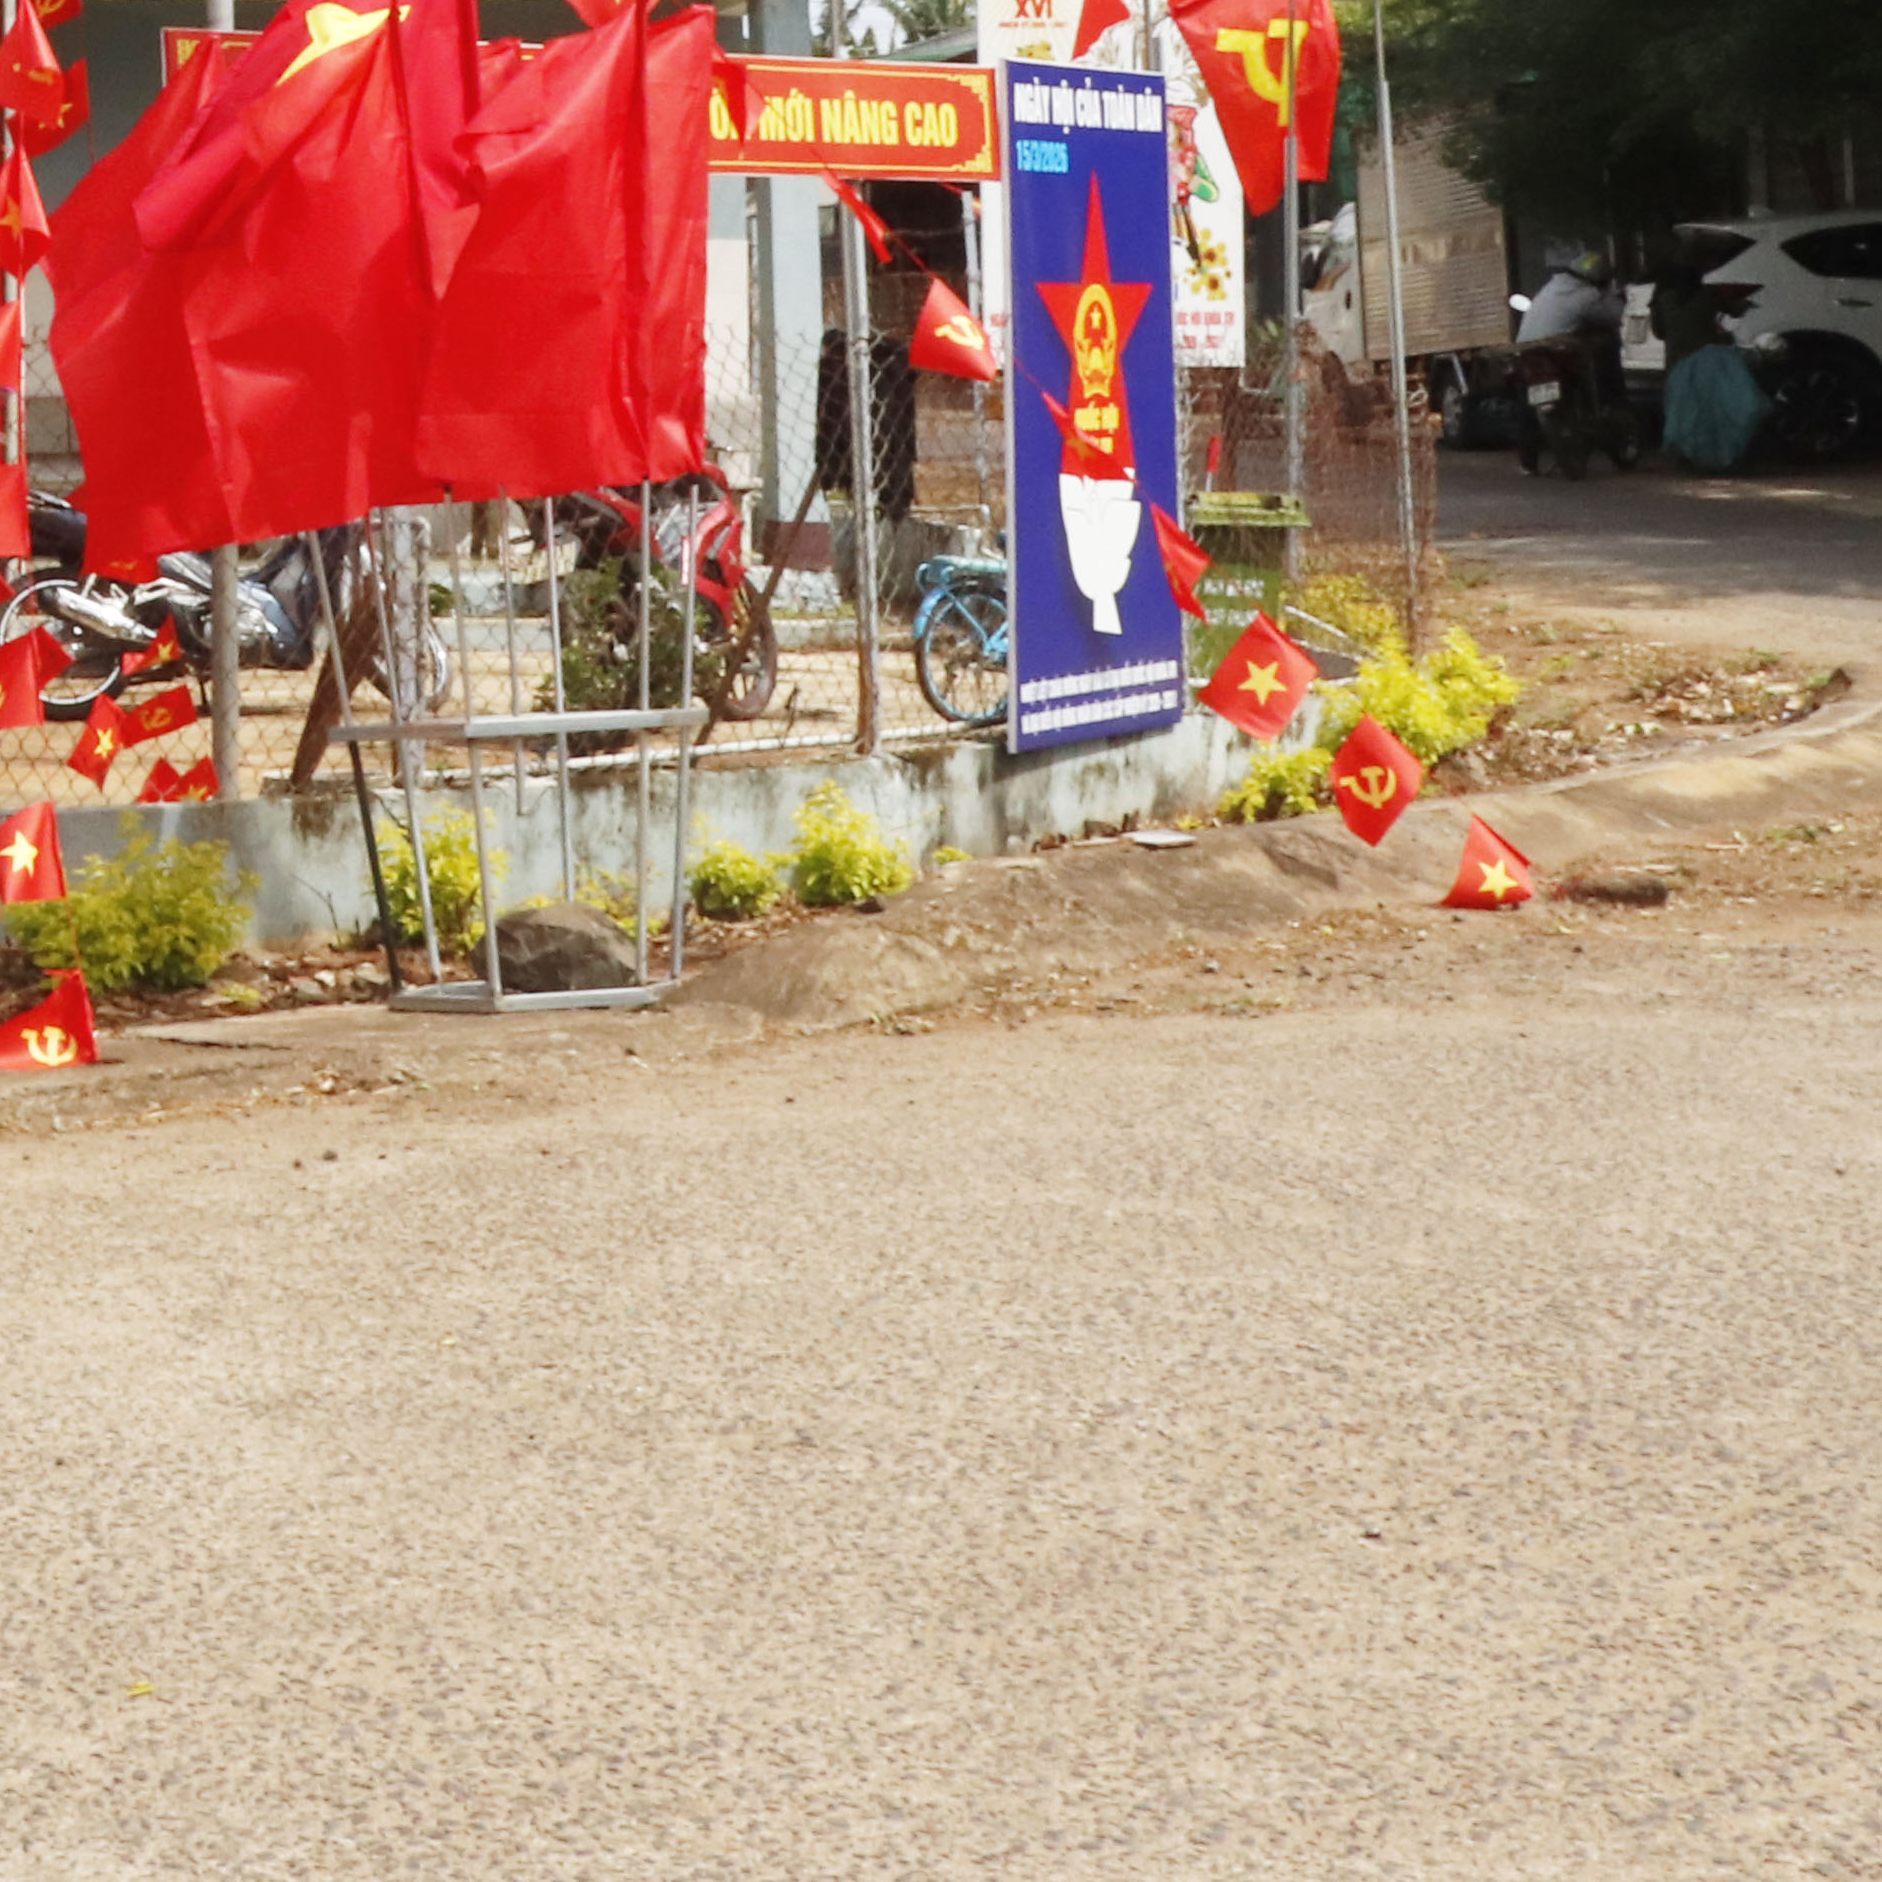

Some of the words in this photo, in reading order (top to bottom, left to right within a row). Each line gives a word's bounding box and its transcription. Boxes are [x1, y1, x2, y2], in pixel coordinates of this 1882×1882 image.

[759, 87, 815, 142] MỚI
[821, 89, 899, 145] NÂNG
[904, 101, 959, 147] CAO
[1014, 76, 1050, 125] NGÀY
[1051, 78, 1075, 135] HỘI
[1075, 76, 1102, 128] CỦA
[1102, 83, 1135, 131] TOÀN
[1136, 86, 1162, 133] DÂN
